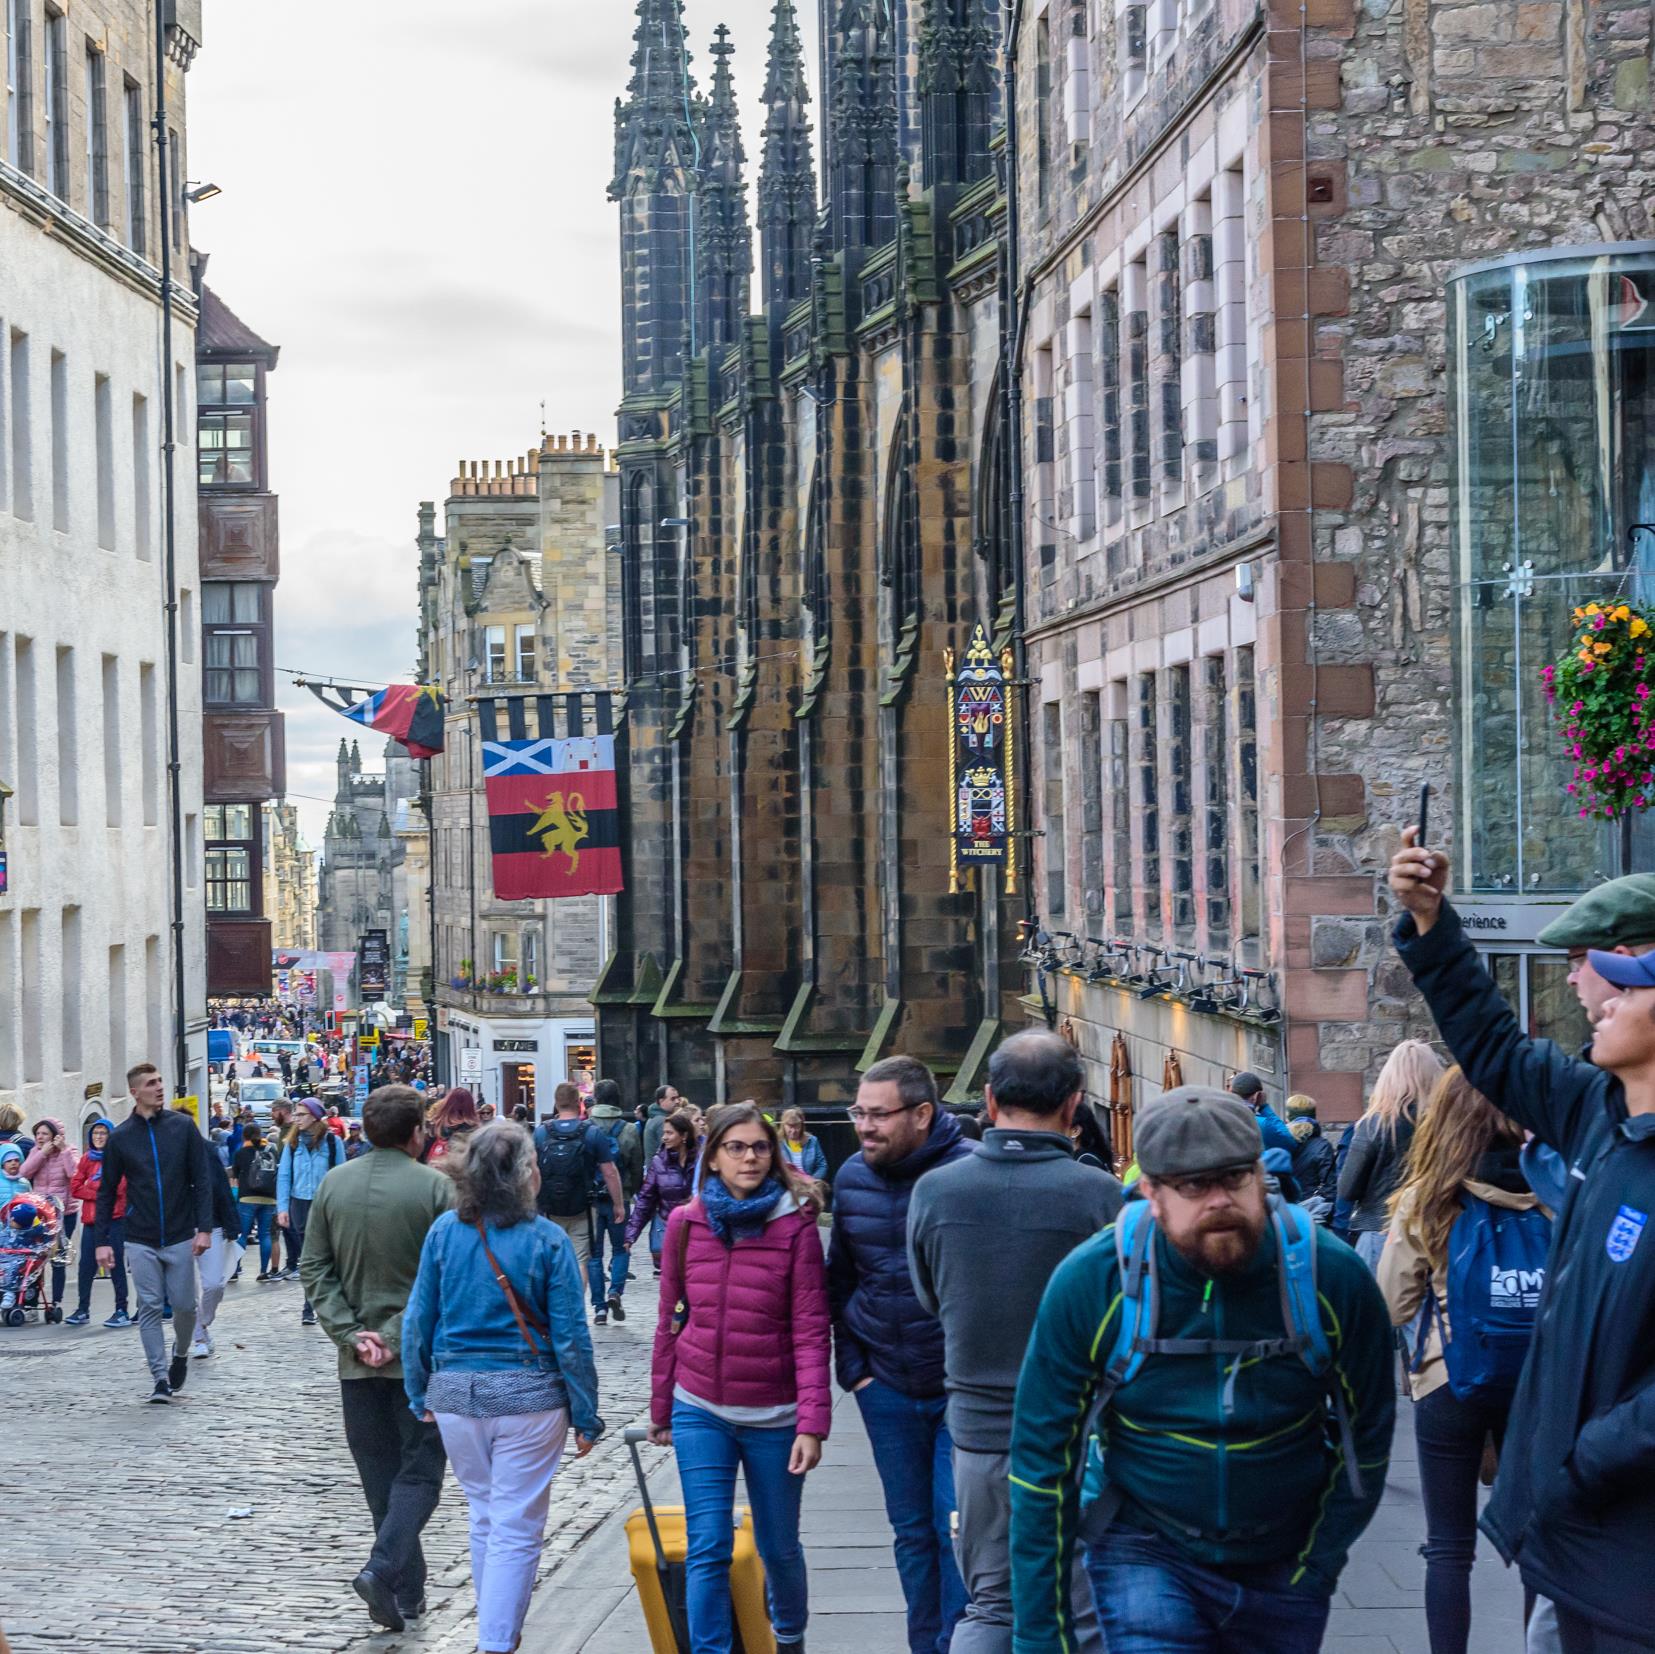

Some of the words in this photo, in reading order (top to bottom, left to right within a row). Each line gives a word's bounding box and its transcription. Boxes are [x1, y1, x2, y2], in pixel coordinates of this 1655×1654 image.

[969, 687, 992, 701] W
[973, 840, 991, 848] THE
[960, 848, 1003, 856] WITCHERY
[1462, 913, 1506, 929] erience
[1519, 1268, 1546, 1291] M
